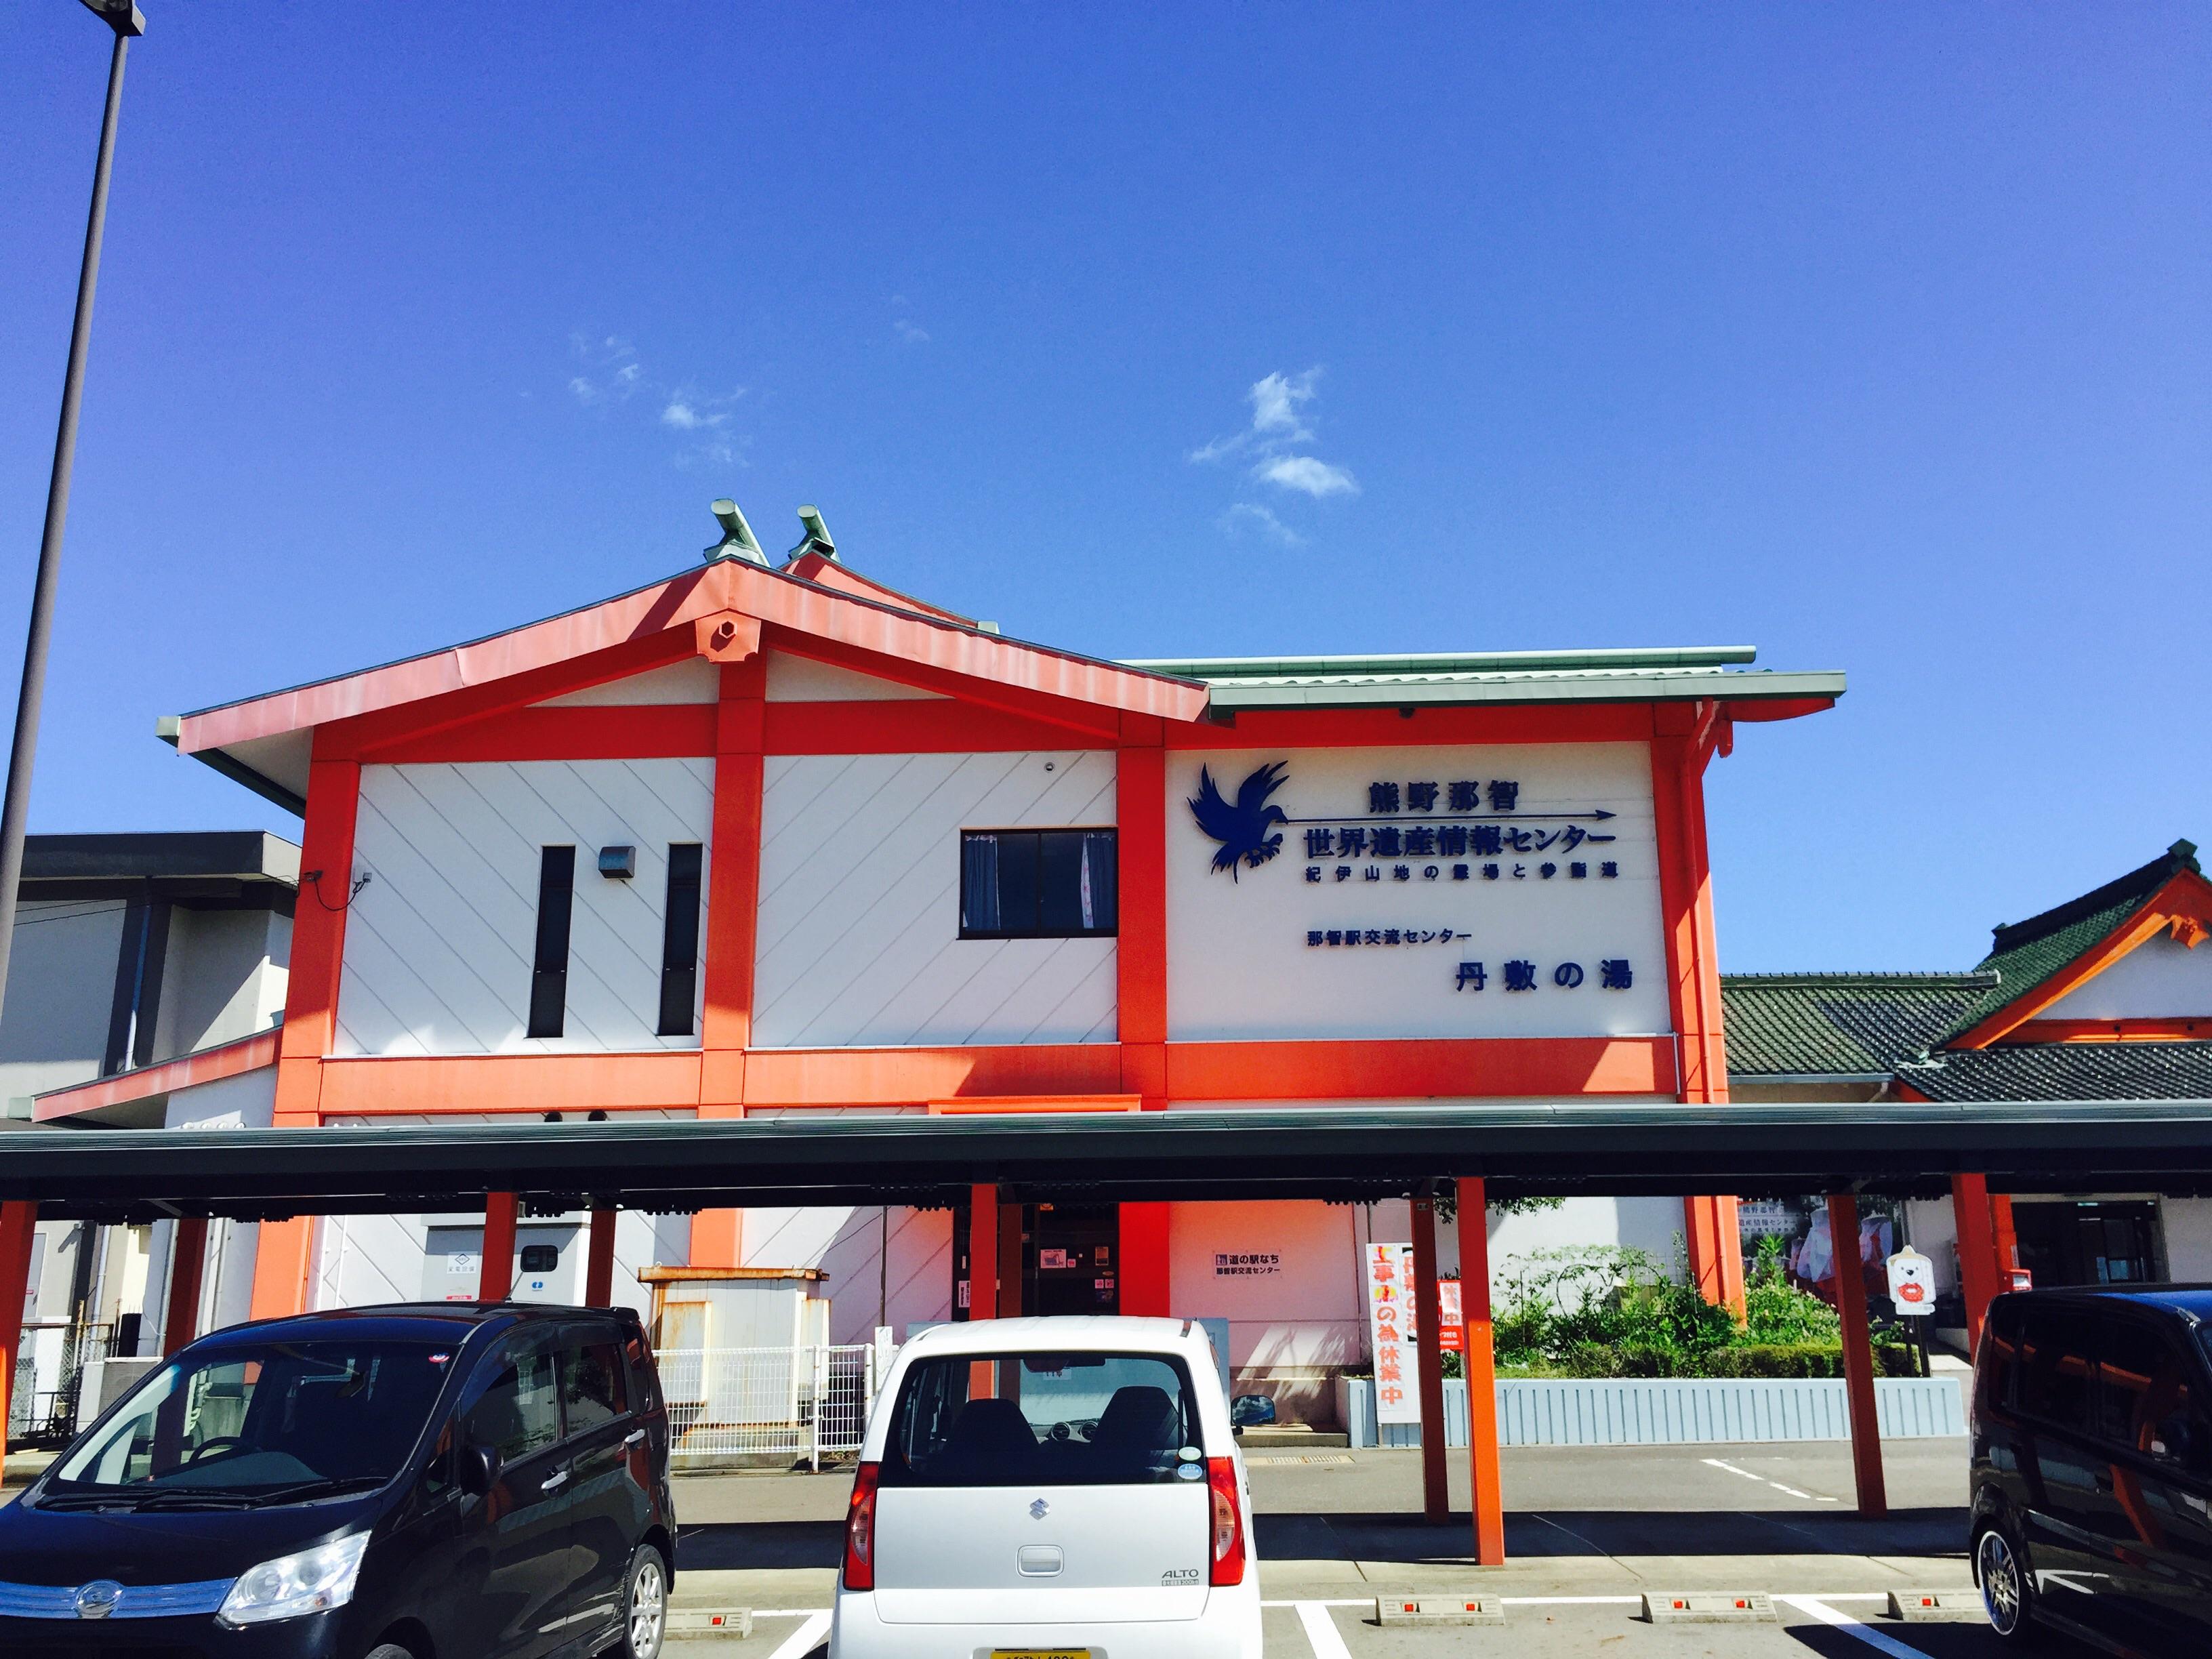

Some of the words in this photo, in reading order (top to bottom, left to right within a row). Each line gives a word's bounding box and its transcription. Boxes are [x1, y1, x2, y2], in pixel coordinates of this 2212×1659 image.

[1368, 779, 1519, 813] 熊野那智
[1303, 825, 1617, 859] 世界遺産情報センター
[1307, 929, 1472, 947] 那智駅交流センター
[1456, 960, 1633, 991] 丹敷の湯
[1229, 1254, 1279, 1265] 道の駅なち
[1162, 1569, 1199, 1578] ALTO
